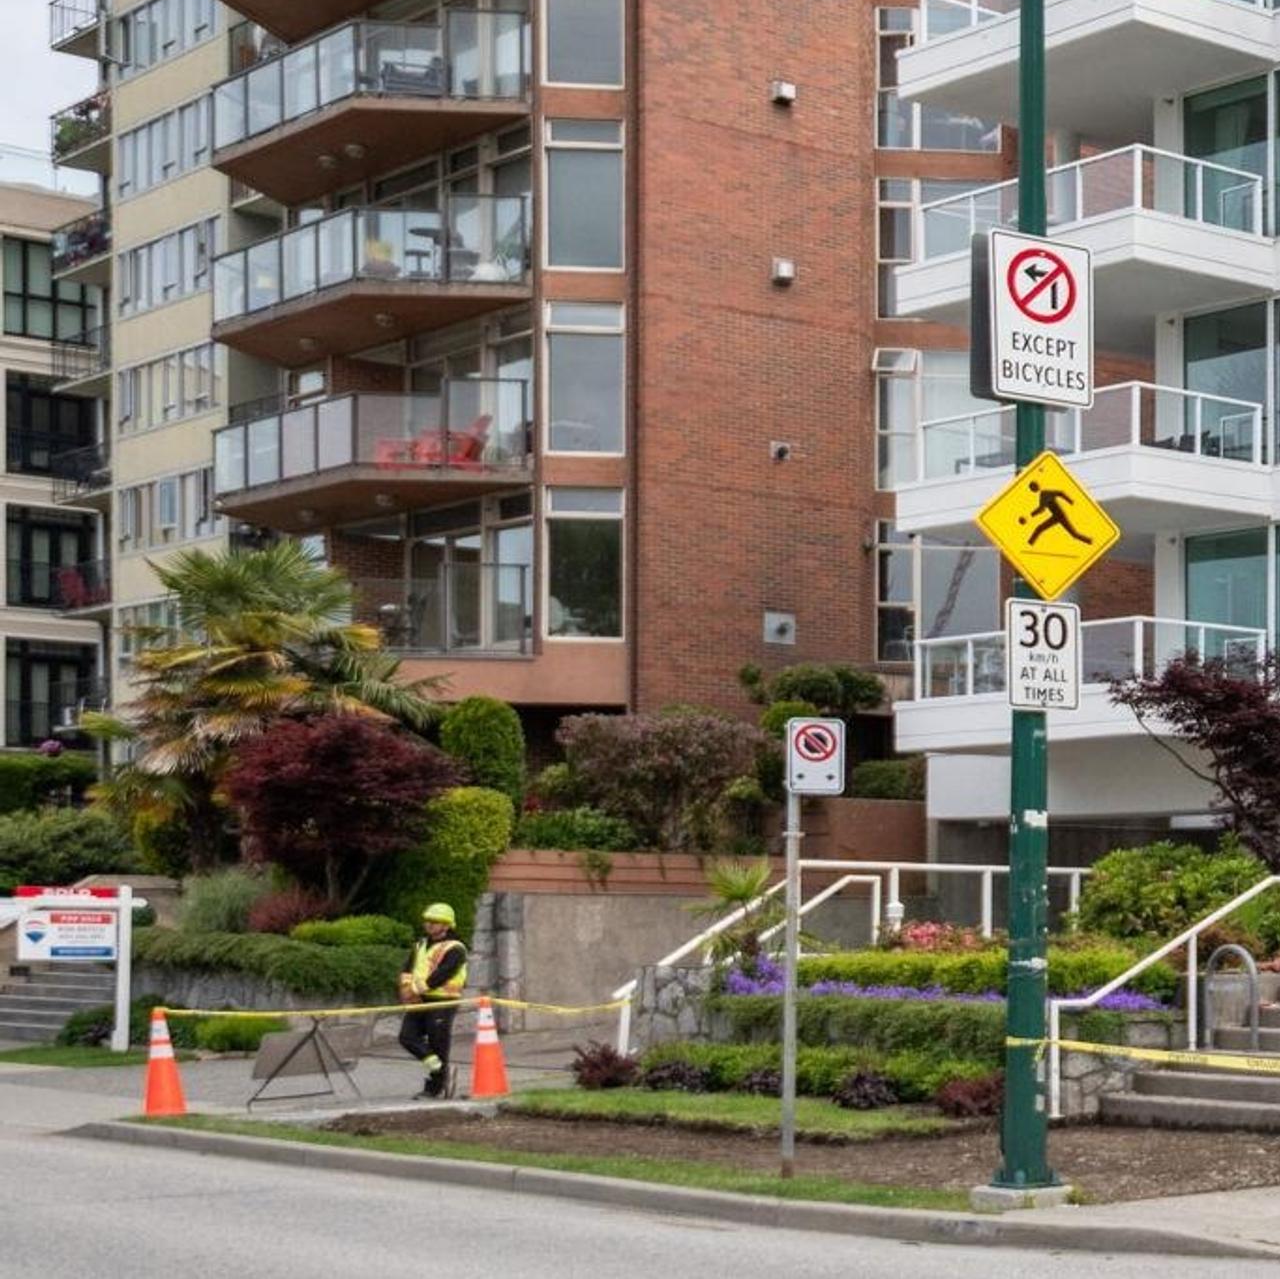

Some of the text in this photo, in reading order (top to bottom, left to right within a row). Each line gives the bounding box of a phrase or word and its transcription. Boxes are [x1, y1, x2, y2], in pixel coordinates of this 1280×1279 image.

[1012, 331, 1077, 360] EXCEPT
[1002, 359, 1085, 391] BICYCLES
[1019, 610, 1068, 650] 30
[1029, 651, 1059, 664] km/h
[1020, 666, 1067, 682] AT ALL
[1024, 686, 1065, 702] TIMES
